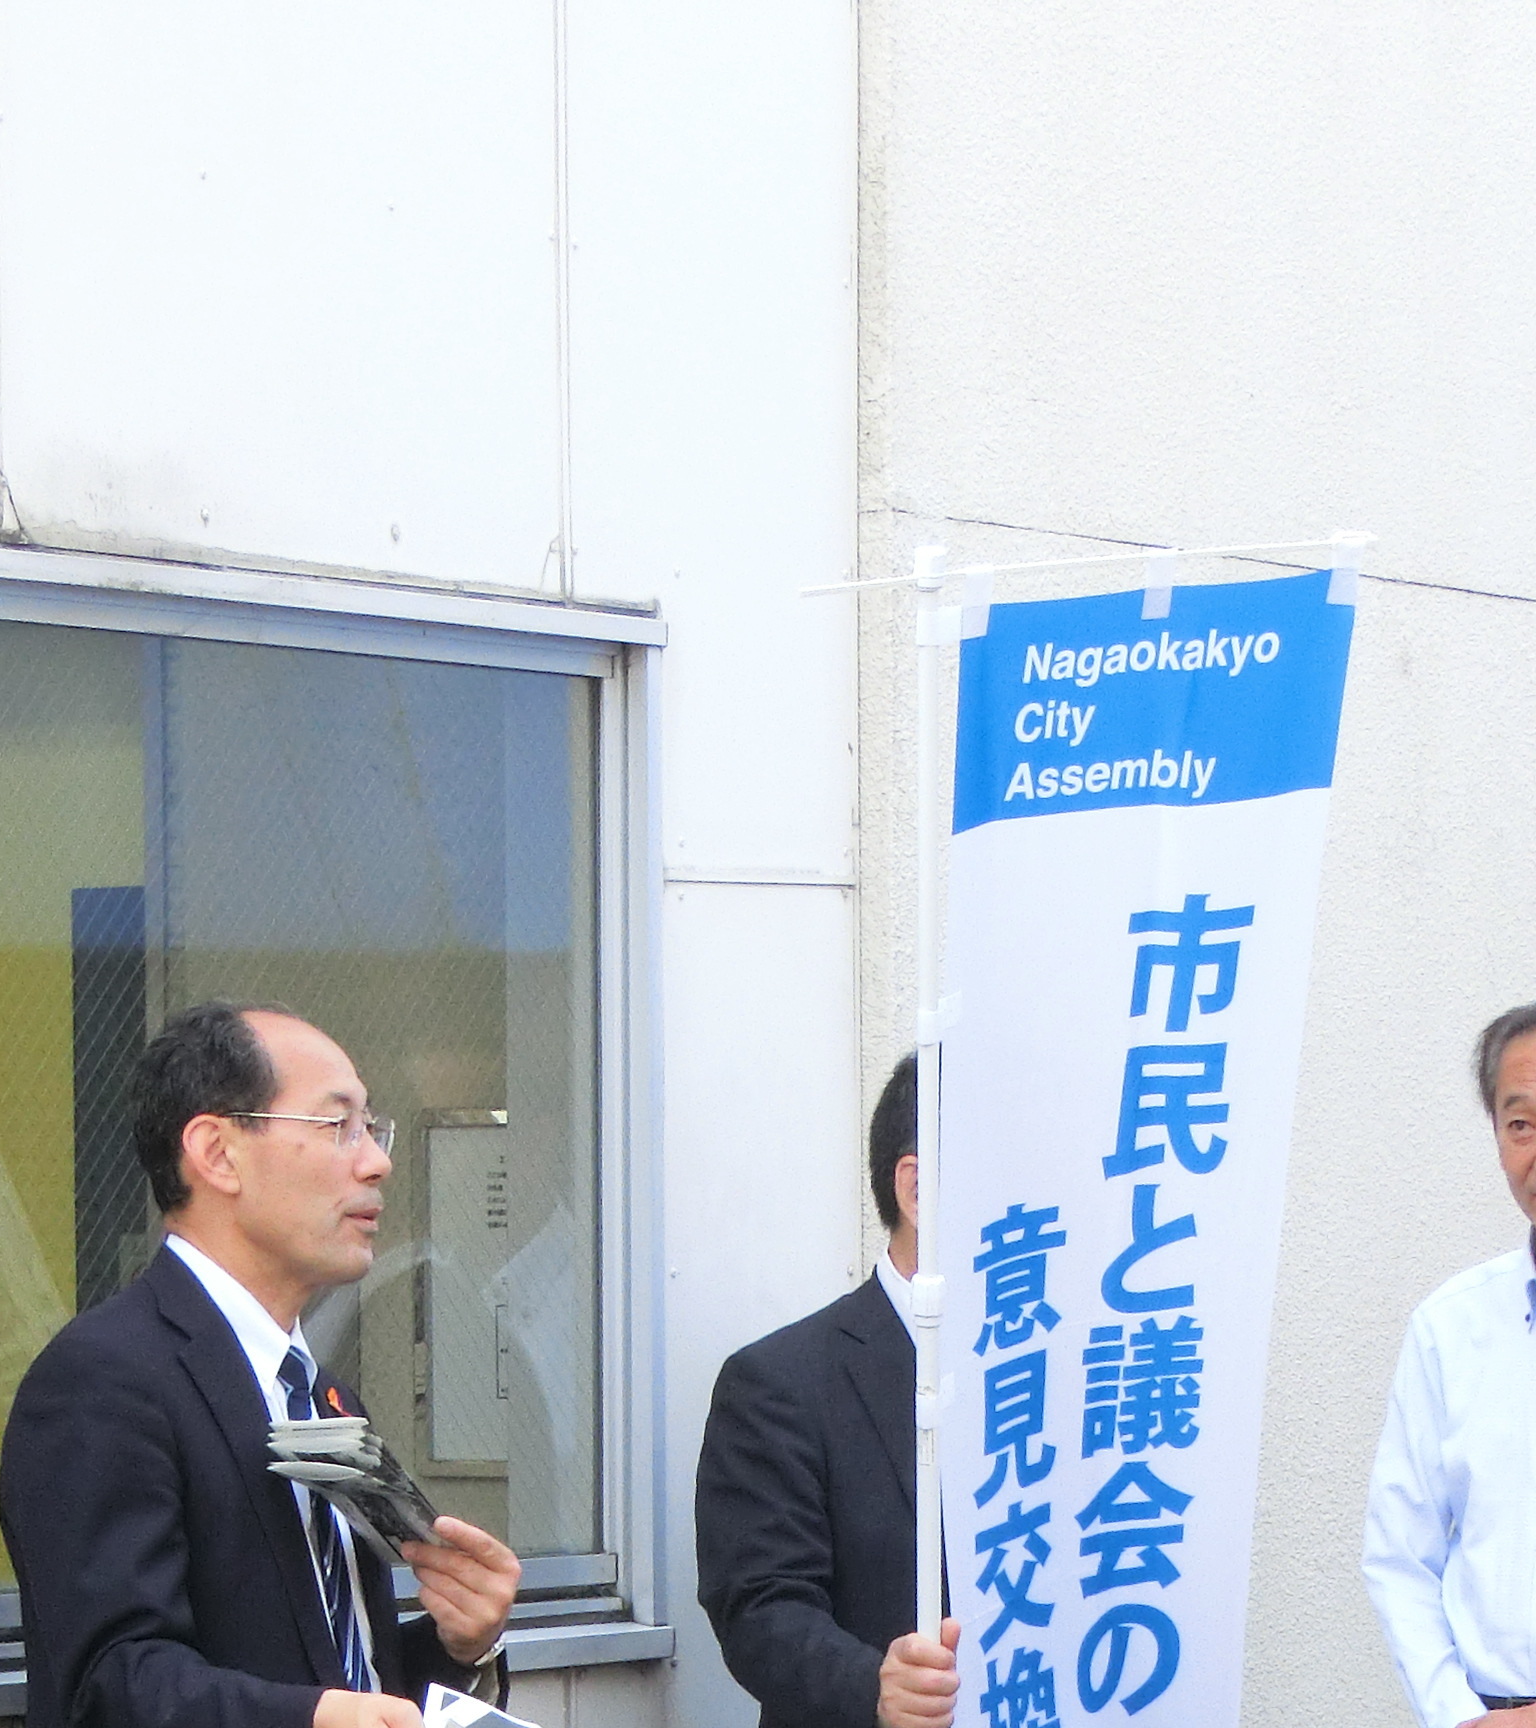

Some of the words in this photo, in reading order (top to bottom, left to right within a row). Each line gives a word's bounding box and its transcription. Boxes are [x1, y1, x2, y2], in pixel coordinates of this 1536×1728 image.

[1022, 628, 1282, 688] Nagaokakyo
[1014, 701, 1097, 748] City
[1004, 749, 1217, 803] Assembly
[1074, 893, 1255, 1718] 市民と議会の
